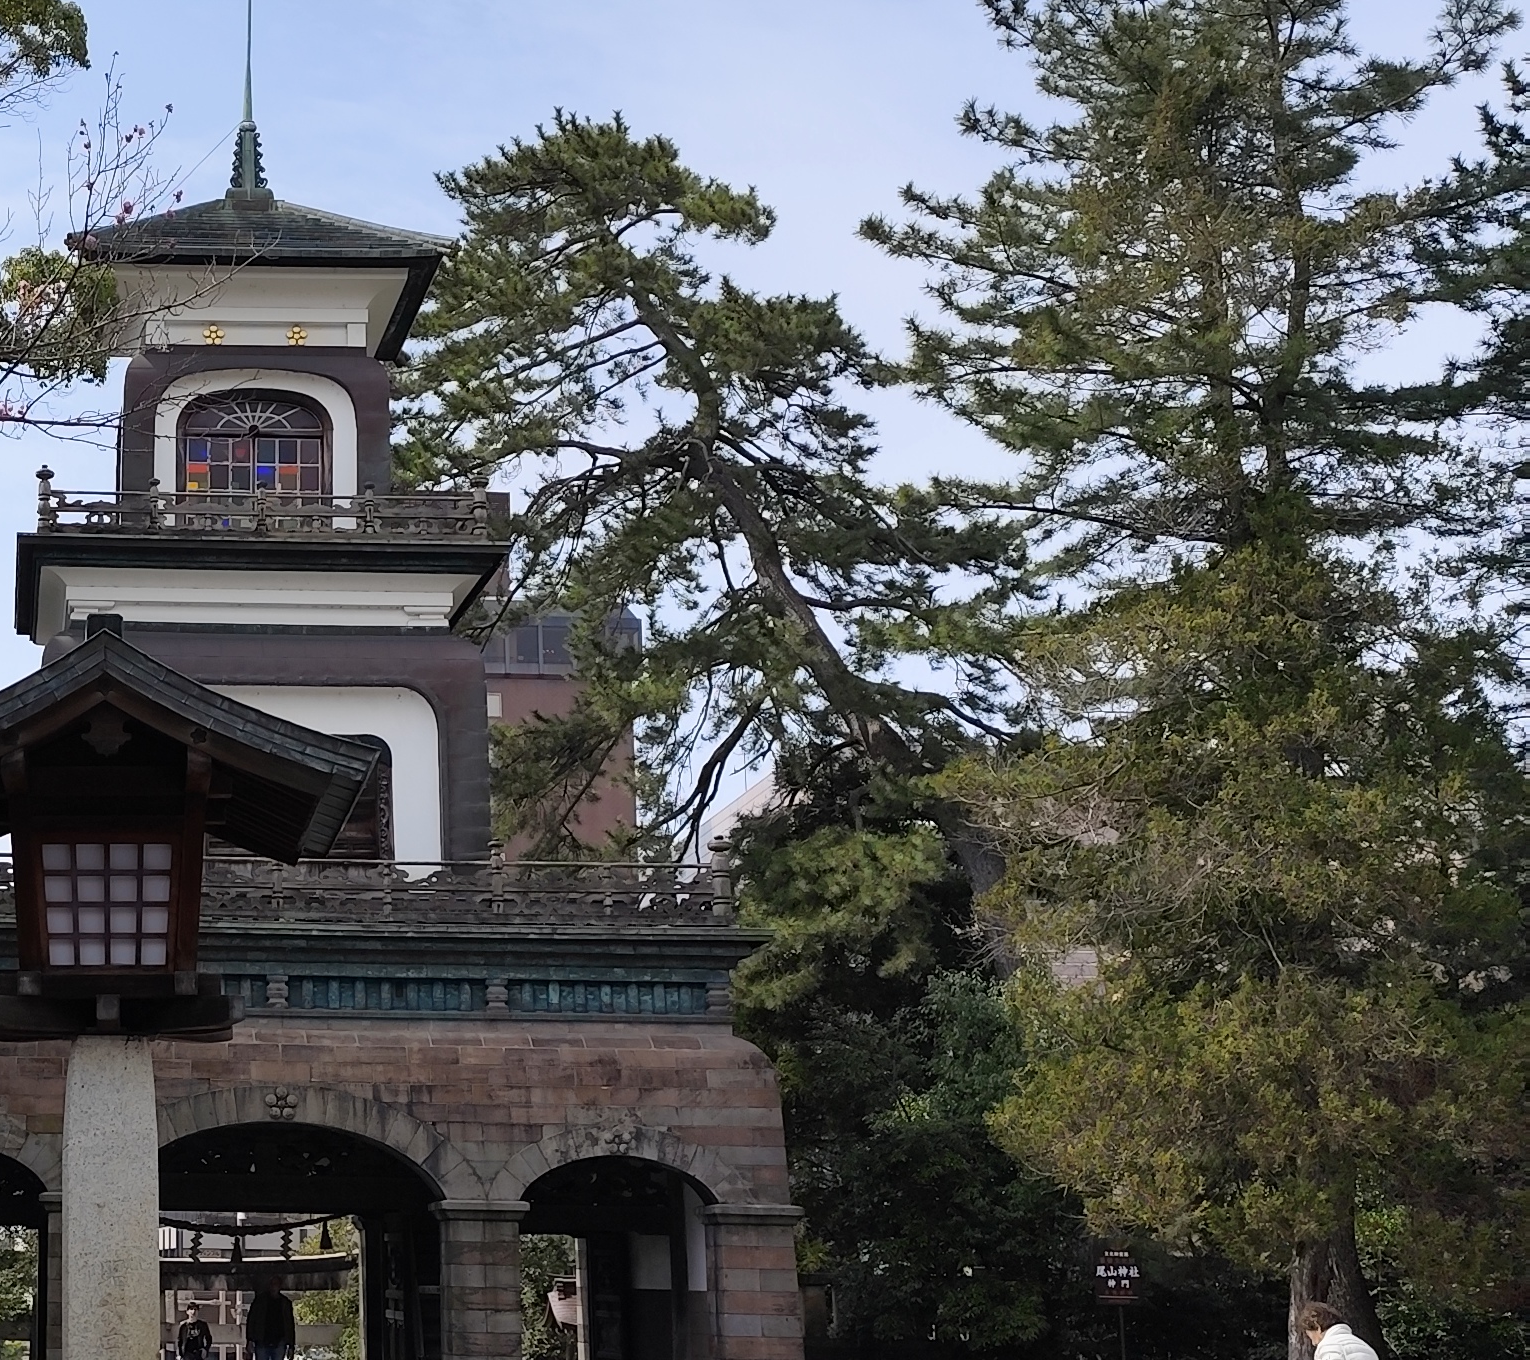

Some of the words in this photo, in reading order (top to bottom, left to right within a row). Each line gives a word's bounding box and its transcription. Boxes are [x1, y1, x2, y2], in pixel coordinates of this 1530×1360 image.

[1095, 1265, 1140, 1278] 尾山神社
[1107, 1278, 1130, 1289] 神門
